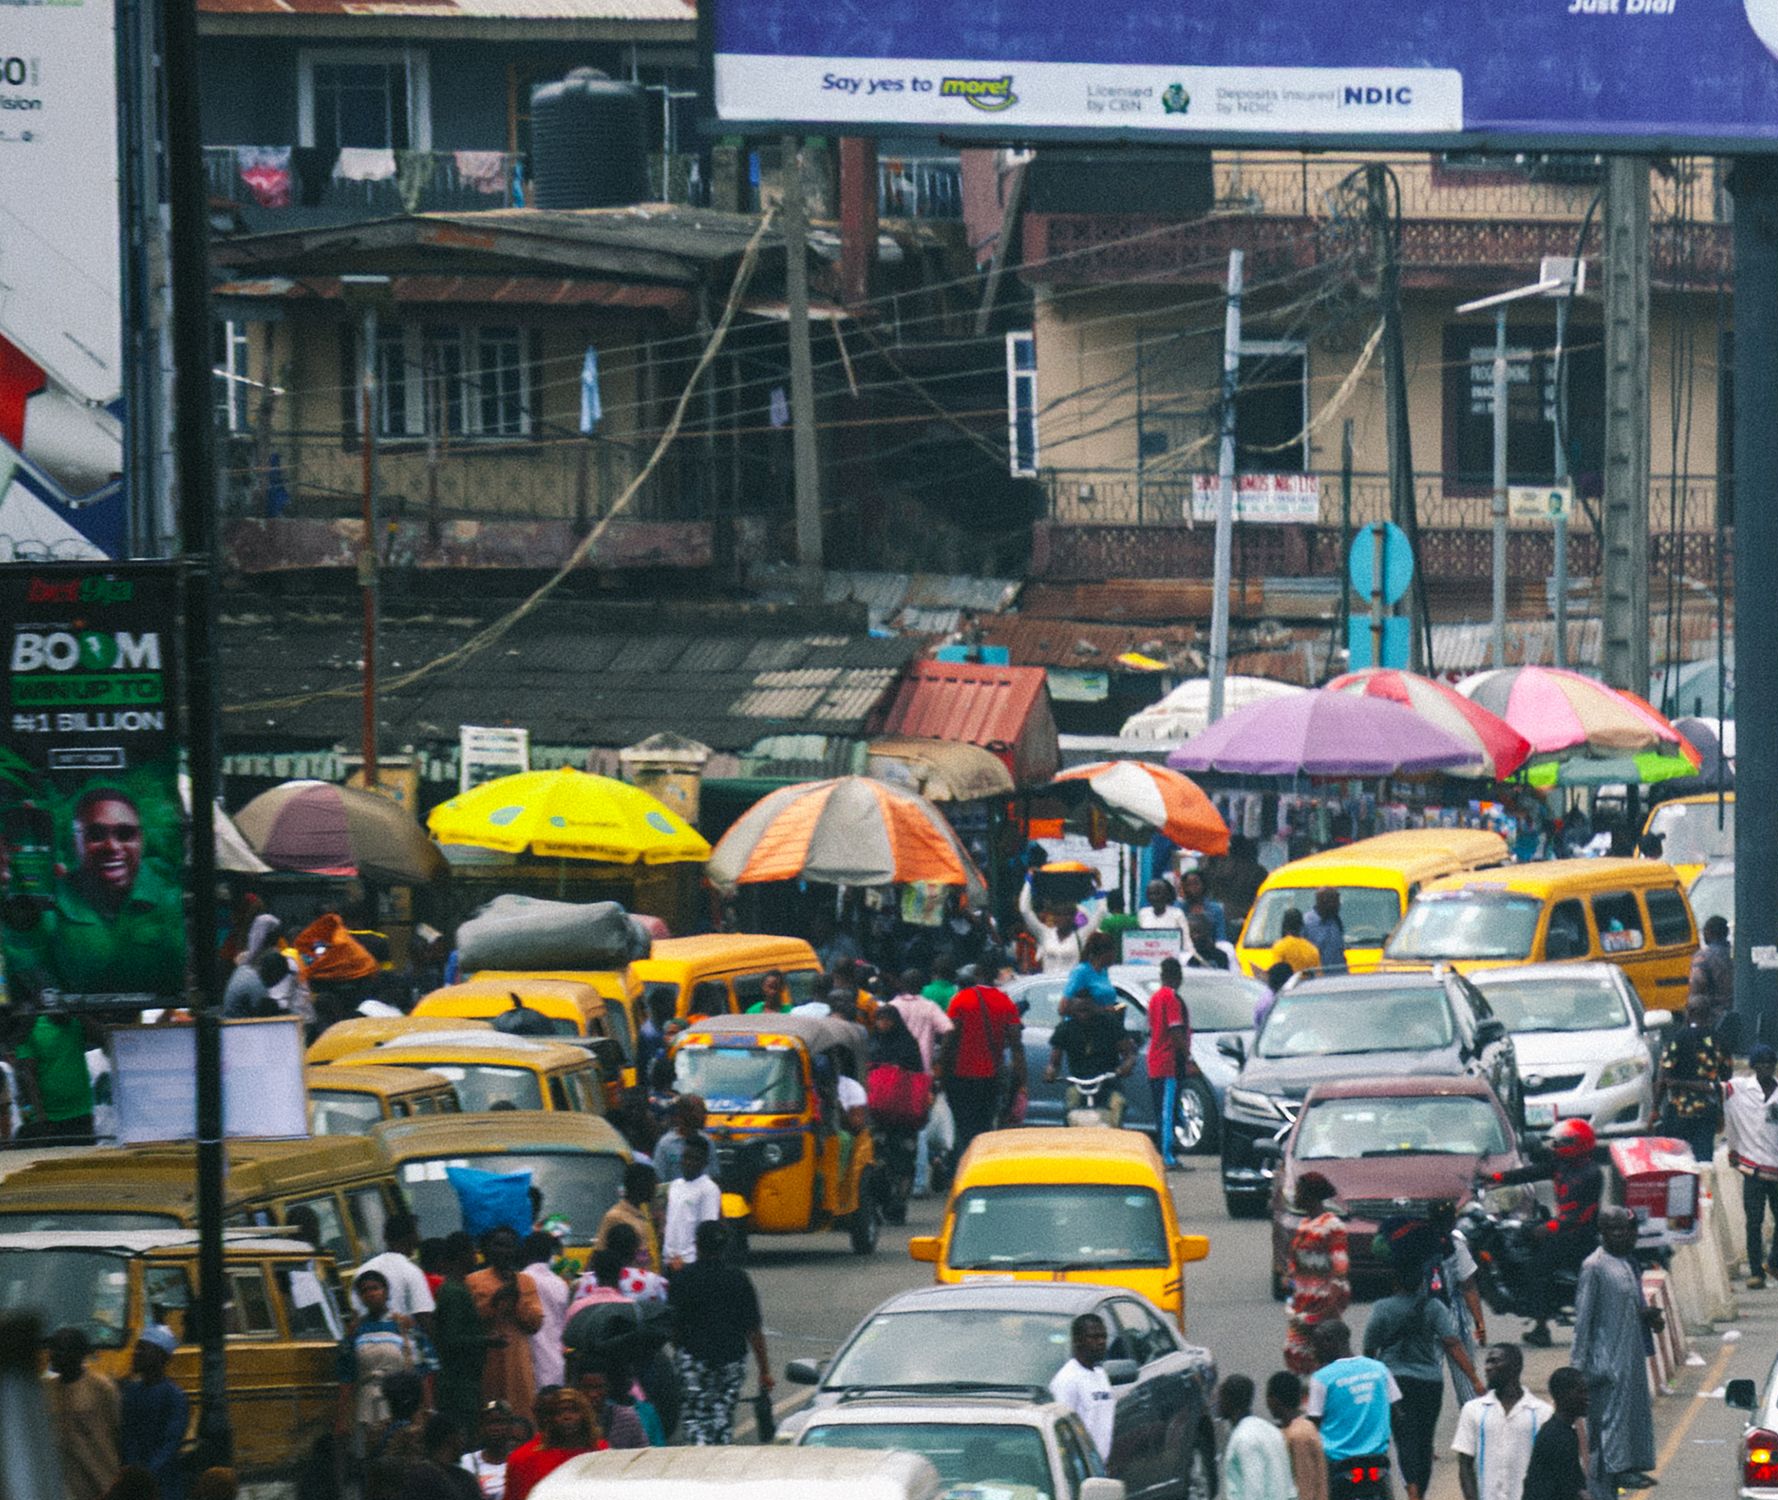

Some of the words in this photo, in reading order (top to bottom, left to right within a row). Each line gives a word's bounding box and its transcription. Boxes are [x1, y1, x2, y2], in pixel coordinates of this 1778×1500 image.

[822, 72, 864, 95] Say
[866, 77, 904, 95] yes
[911, 77, 933, 92] to
[942, 78, 1011, 95] more!
[1343, 87, 1412, 105] NDIC
[1108, 101, 1142, 112] CBN
